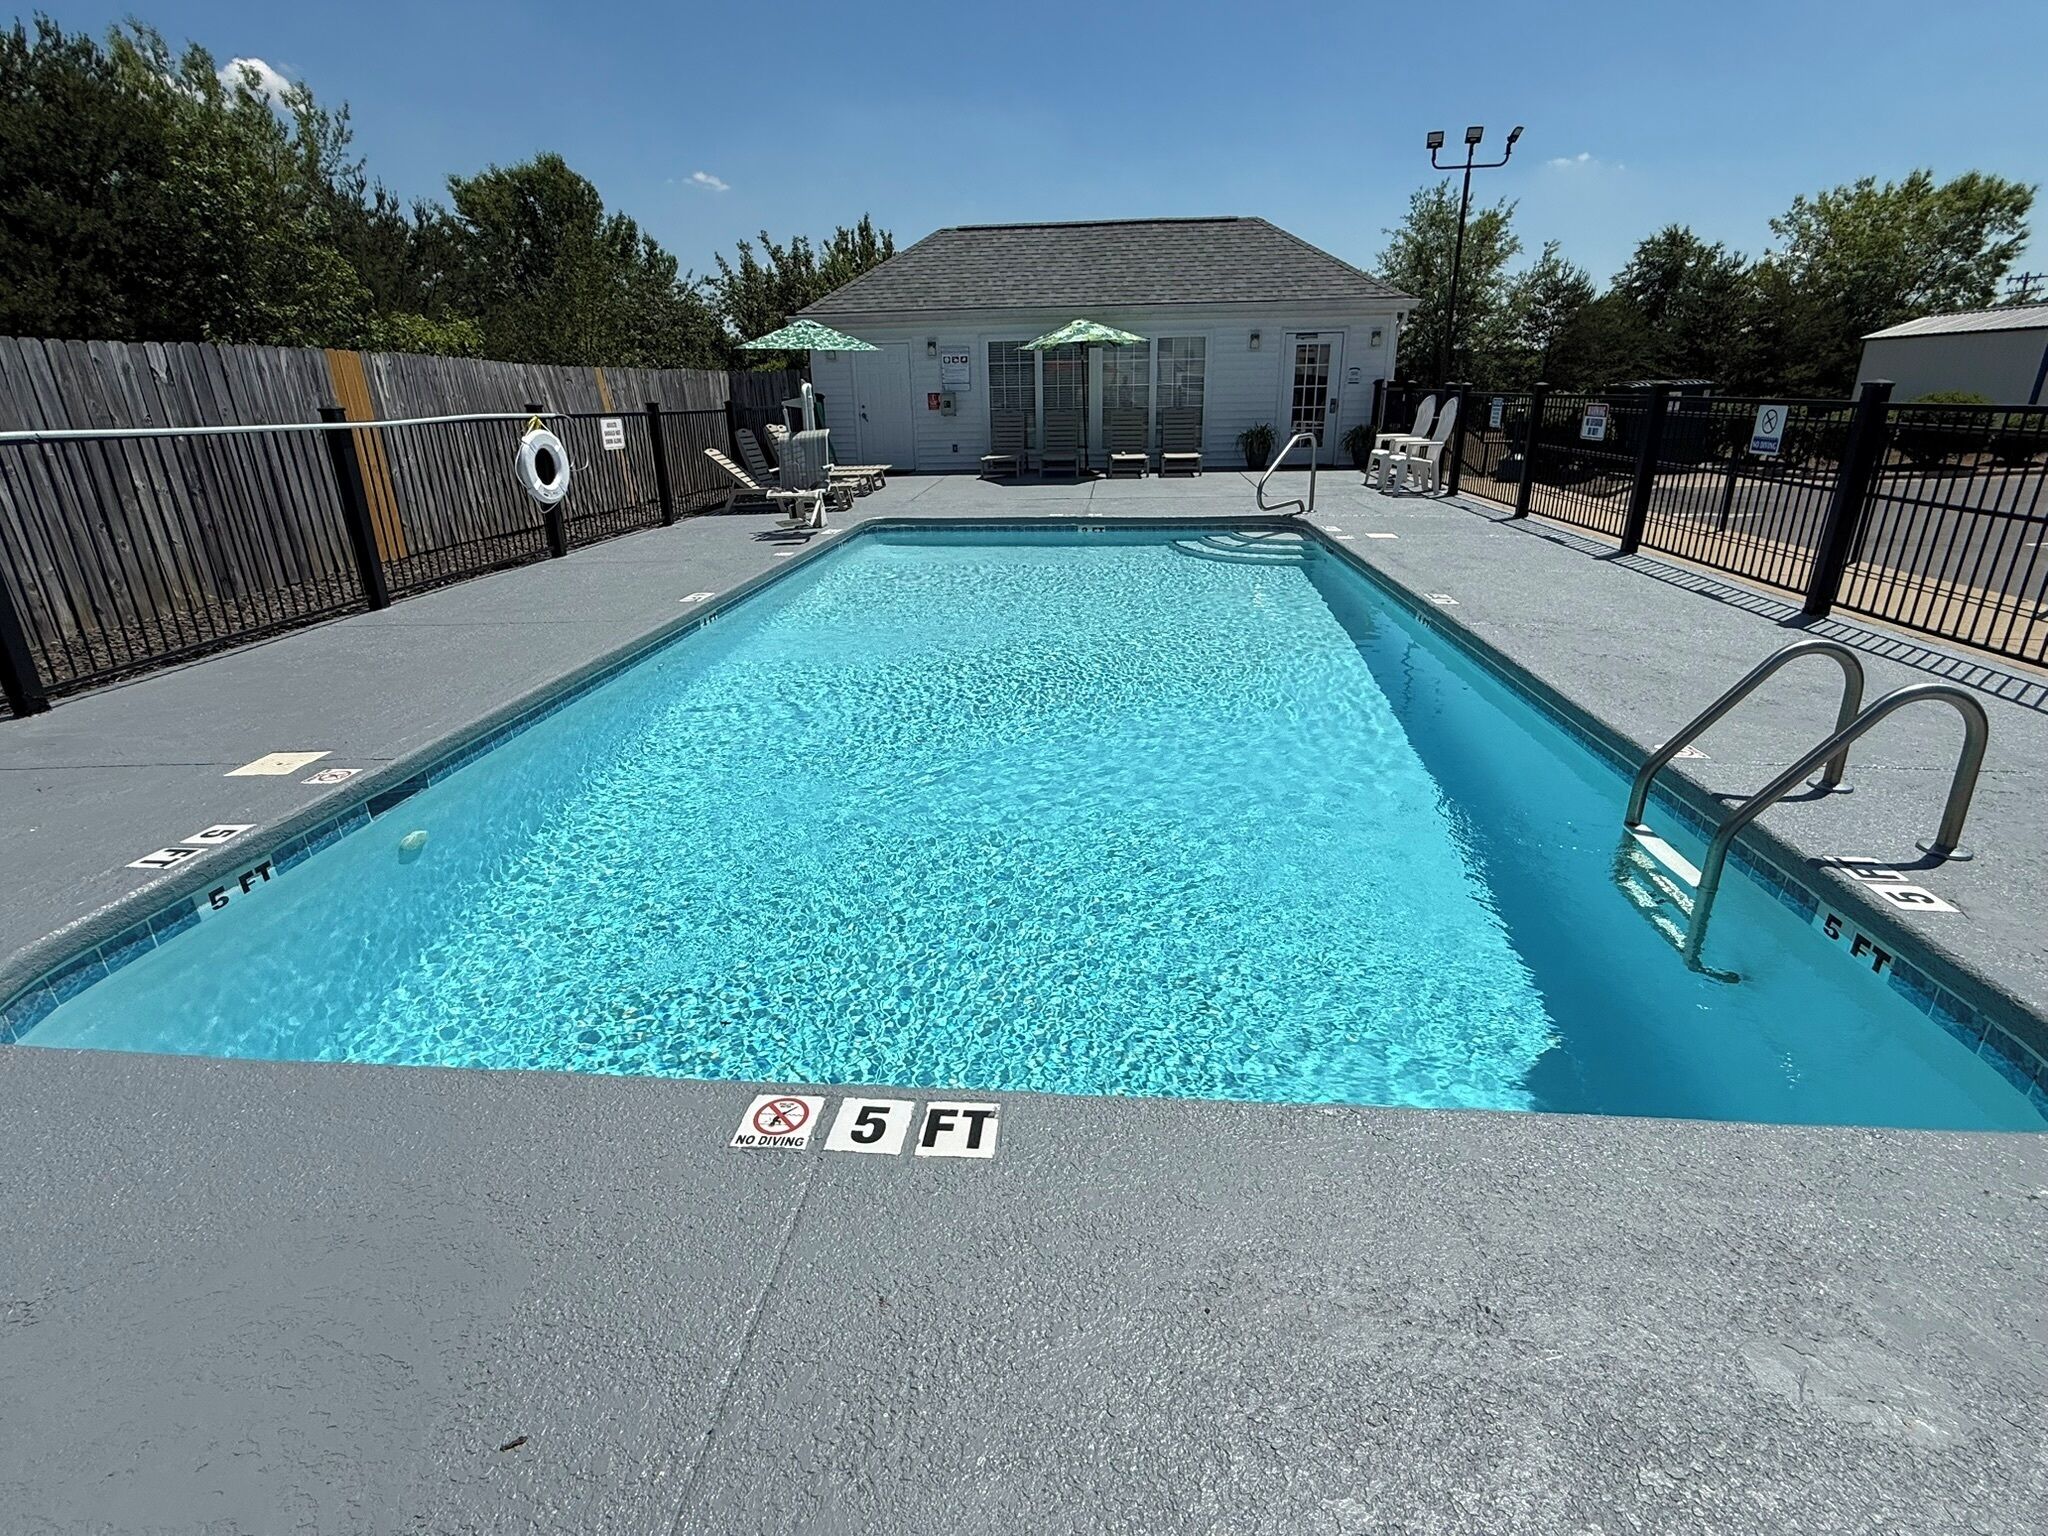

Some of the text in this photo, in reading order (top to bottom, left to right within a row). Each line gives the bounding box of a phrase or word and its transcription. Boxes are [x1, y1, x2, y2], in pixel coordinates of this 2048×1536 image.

[139, 828, 238, 868] 5 FT
[208, 860, 272, 911] 5 FT
[1884, 891, 1935, 904] 5
[1823, 912, 1892, 975] 5 FT
[735, 1134, 805, 1147] NO DIVING
[850, 1105, 996, 1149] 5 FT
